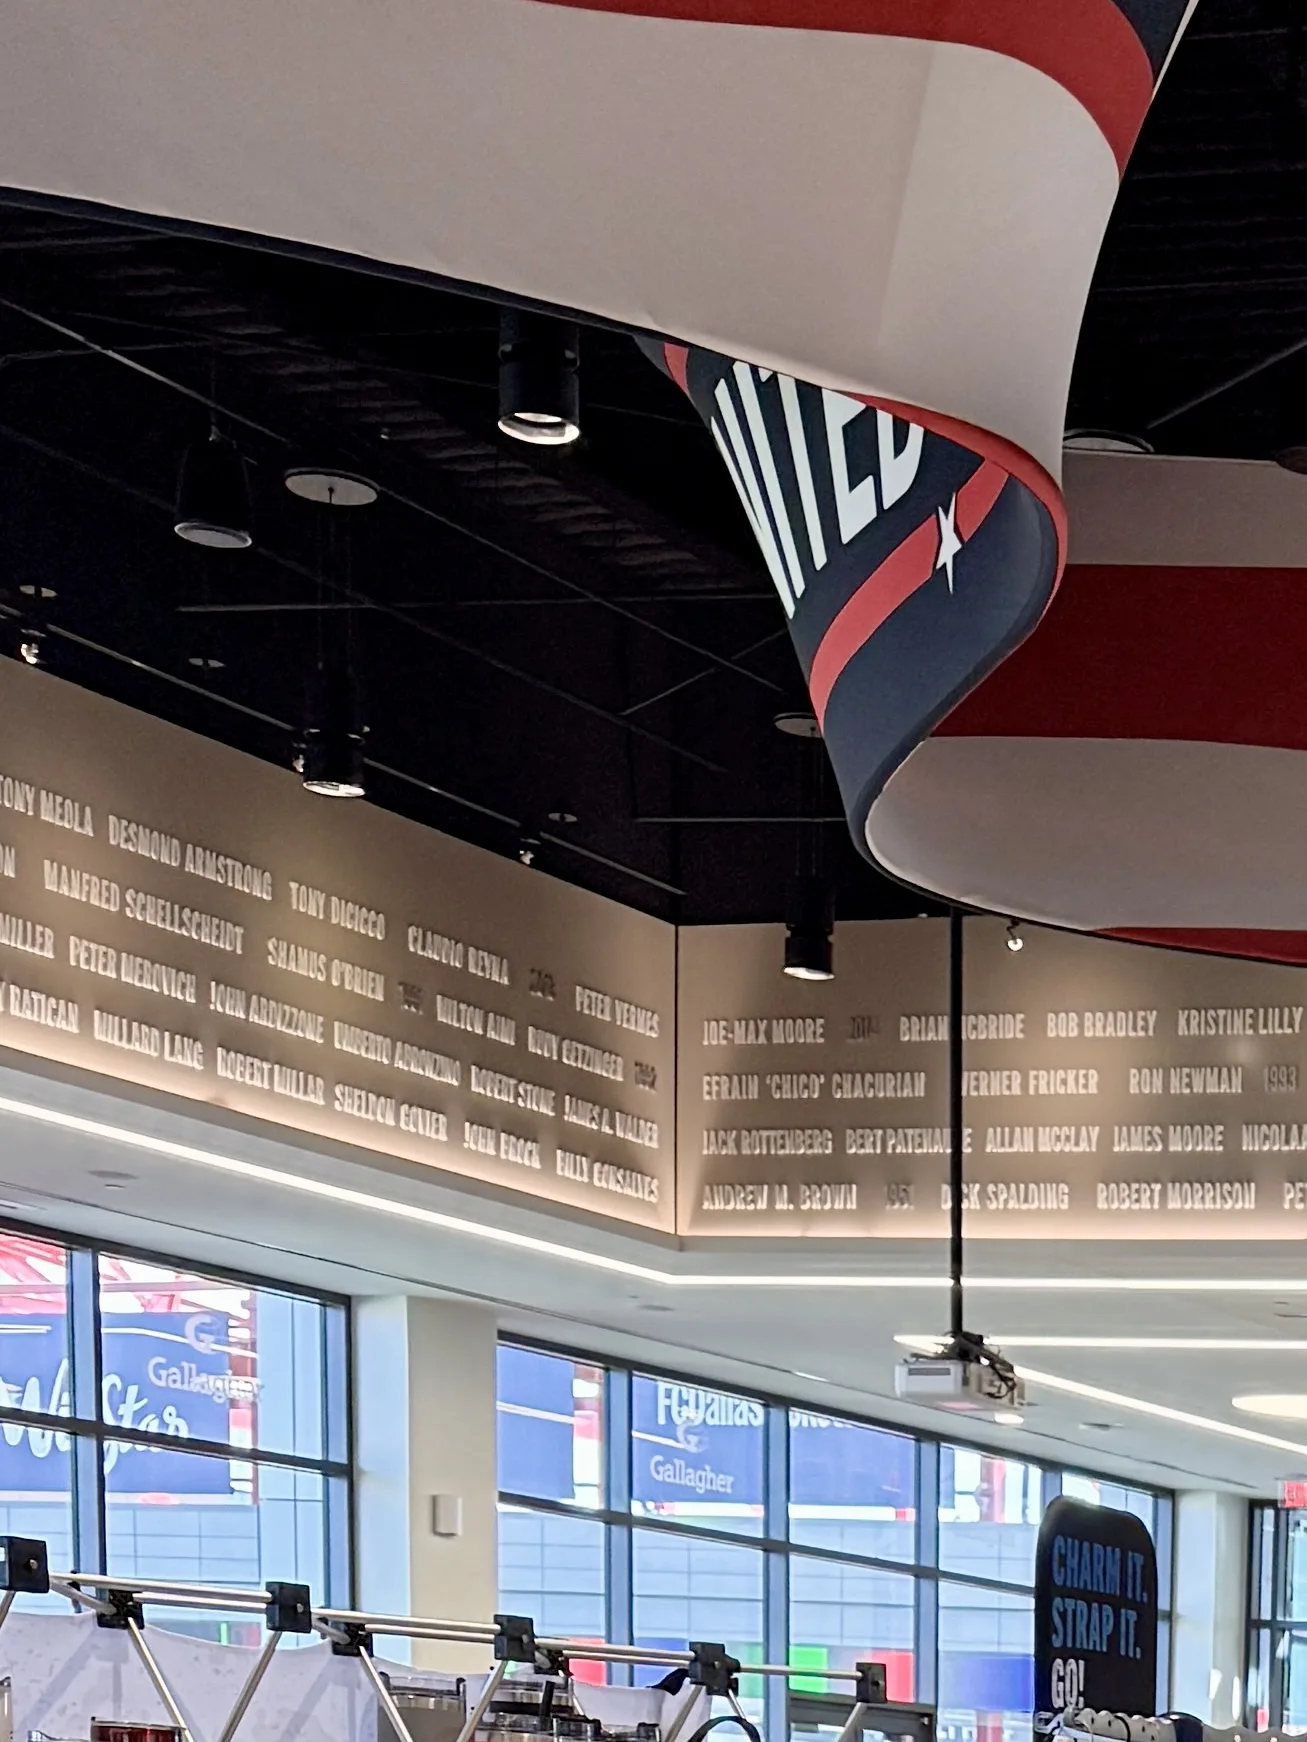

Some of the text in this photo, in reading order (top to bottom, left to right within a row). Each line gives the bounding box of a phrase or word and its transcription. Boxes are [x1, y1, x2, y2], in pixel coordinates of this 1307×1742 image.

[40, 790, 94, 837] MEOLA
[109, 815, 180, 867] DESMOND
[185, 844, 272, 900] ARMSTRONG
[289, 882, 325, 920] TONY
[331, 896, 385, 940] DICICCO
[575, 985, 611, 1022] PETER
[44, 859, 120, 911] MANFRED
[125, 888, 244, 954] SCHELLSCHEIDT
[267, 937, 326, 982] SHAMUS
[331, 959, 384, 1001] O'BRIEN
[69, 936, 117, 978] PETER
[121, 952, 196, 1003] MEROVICH
[210, 981, 246, 1019] JOHN
[250, 995, 324, 1043] ARDIZZONE
[10, 984, 80, 1033] RATICAN
[94, 1009, 160, 1057] MILLARD
[164, 1031, 204, 1070] LANG
[217, 1047, 271, 1089] ROBERT
[274, 1064, 326, 1105] MILLAR
[334, 1084, 395, 1126] SHELDON
[702, 1018, 767, 1046] JOE-MAX
[772, 1017, 825, 1044] MOORE
[899, 1015, 950, 1042] BRIAN
[1047, 1012, 1079, 1038] BOB
[1084, 1010, 1157, 1038] BRADLEY
[1178, 1008, 1255, 1037] KRISTINE
[1258, 1007, 1303, 1035] LILLY
[702, 1073, 759, 1101] EFRAIN
[832, 1072, 926, 1099] CHACURIAN
[1029, 1069, 1099, 1096] FRICKER
[1129, 1068, 1163, 1095] RON
[1169, 1066, 1243, 1095] NEWMAN
[1264, 1065, 1297, 1093] 1993
[702, 1129, 738, 1156] JACK
[741, 1129, 833, 1156] ROTTENBERG
[846, 1128, 883, 1155] BERT
[886, 1128, 973, 1155] PATENAUE
[986, 1126, 1034, 1154] ALLAN
[1113, 1125, 1163, 1153] JAMES
[1168, 1124, 1224, 1152] MOORE
[702, 1184, 769, 1211] ANDREW
[774, 1184, 794, 1211] M.
[800, 1184, 857, 1210] BROWN
[986, 1183, 1069, 1210] SPALDING
[1097, 1183, 1162, 1210] ROBERT
[1167, 1182, 1256, 1210] MORRISON
[650, 1455, 735, 1494] Gallagher
[1052, 1534, 1148, 1604] CHARM IT.
[1051, 1596, 1141, 1659] STRAP IT.
[1051, 1658, 1085, 1709] GO!
